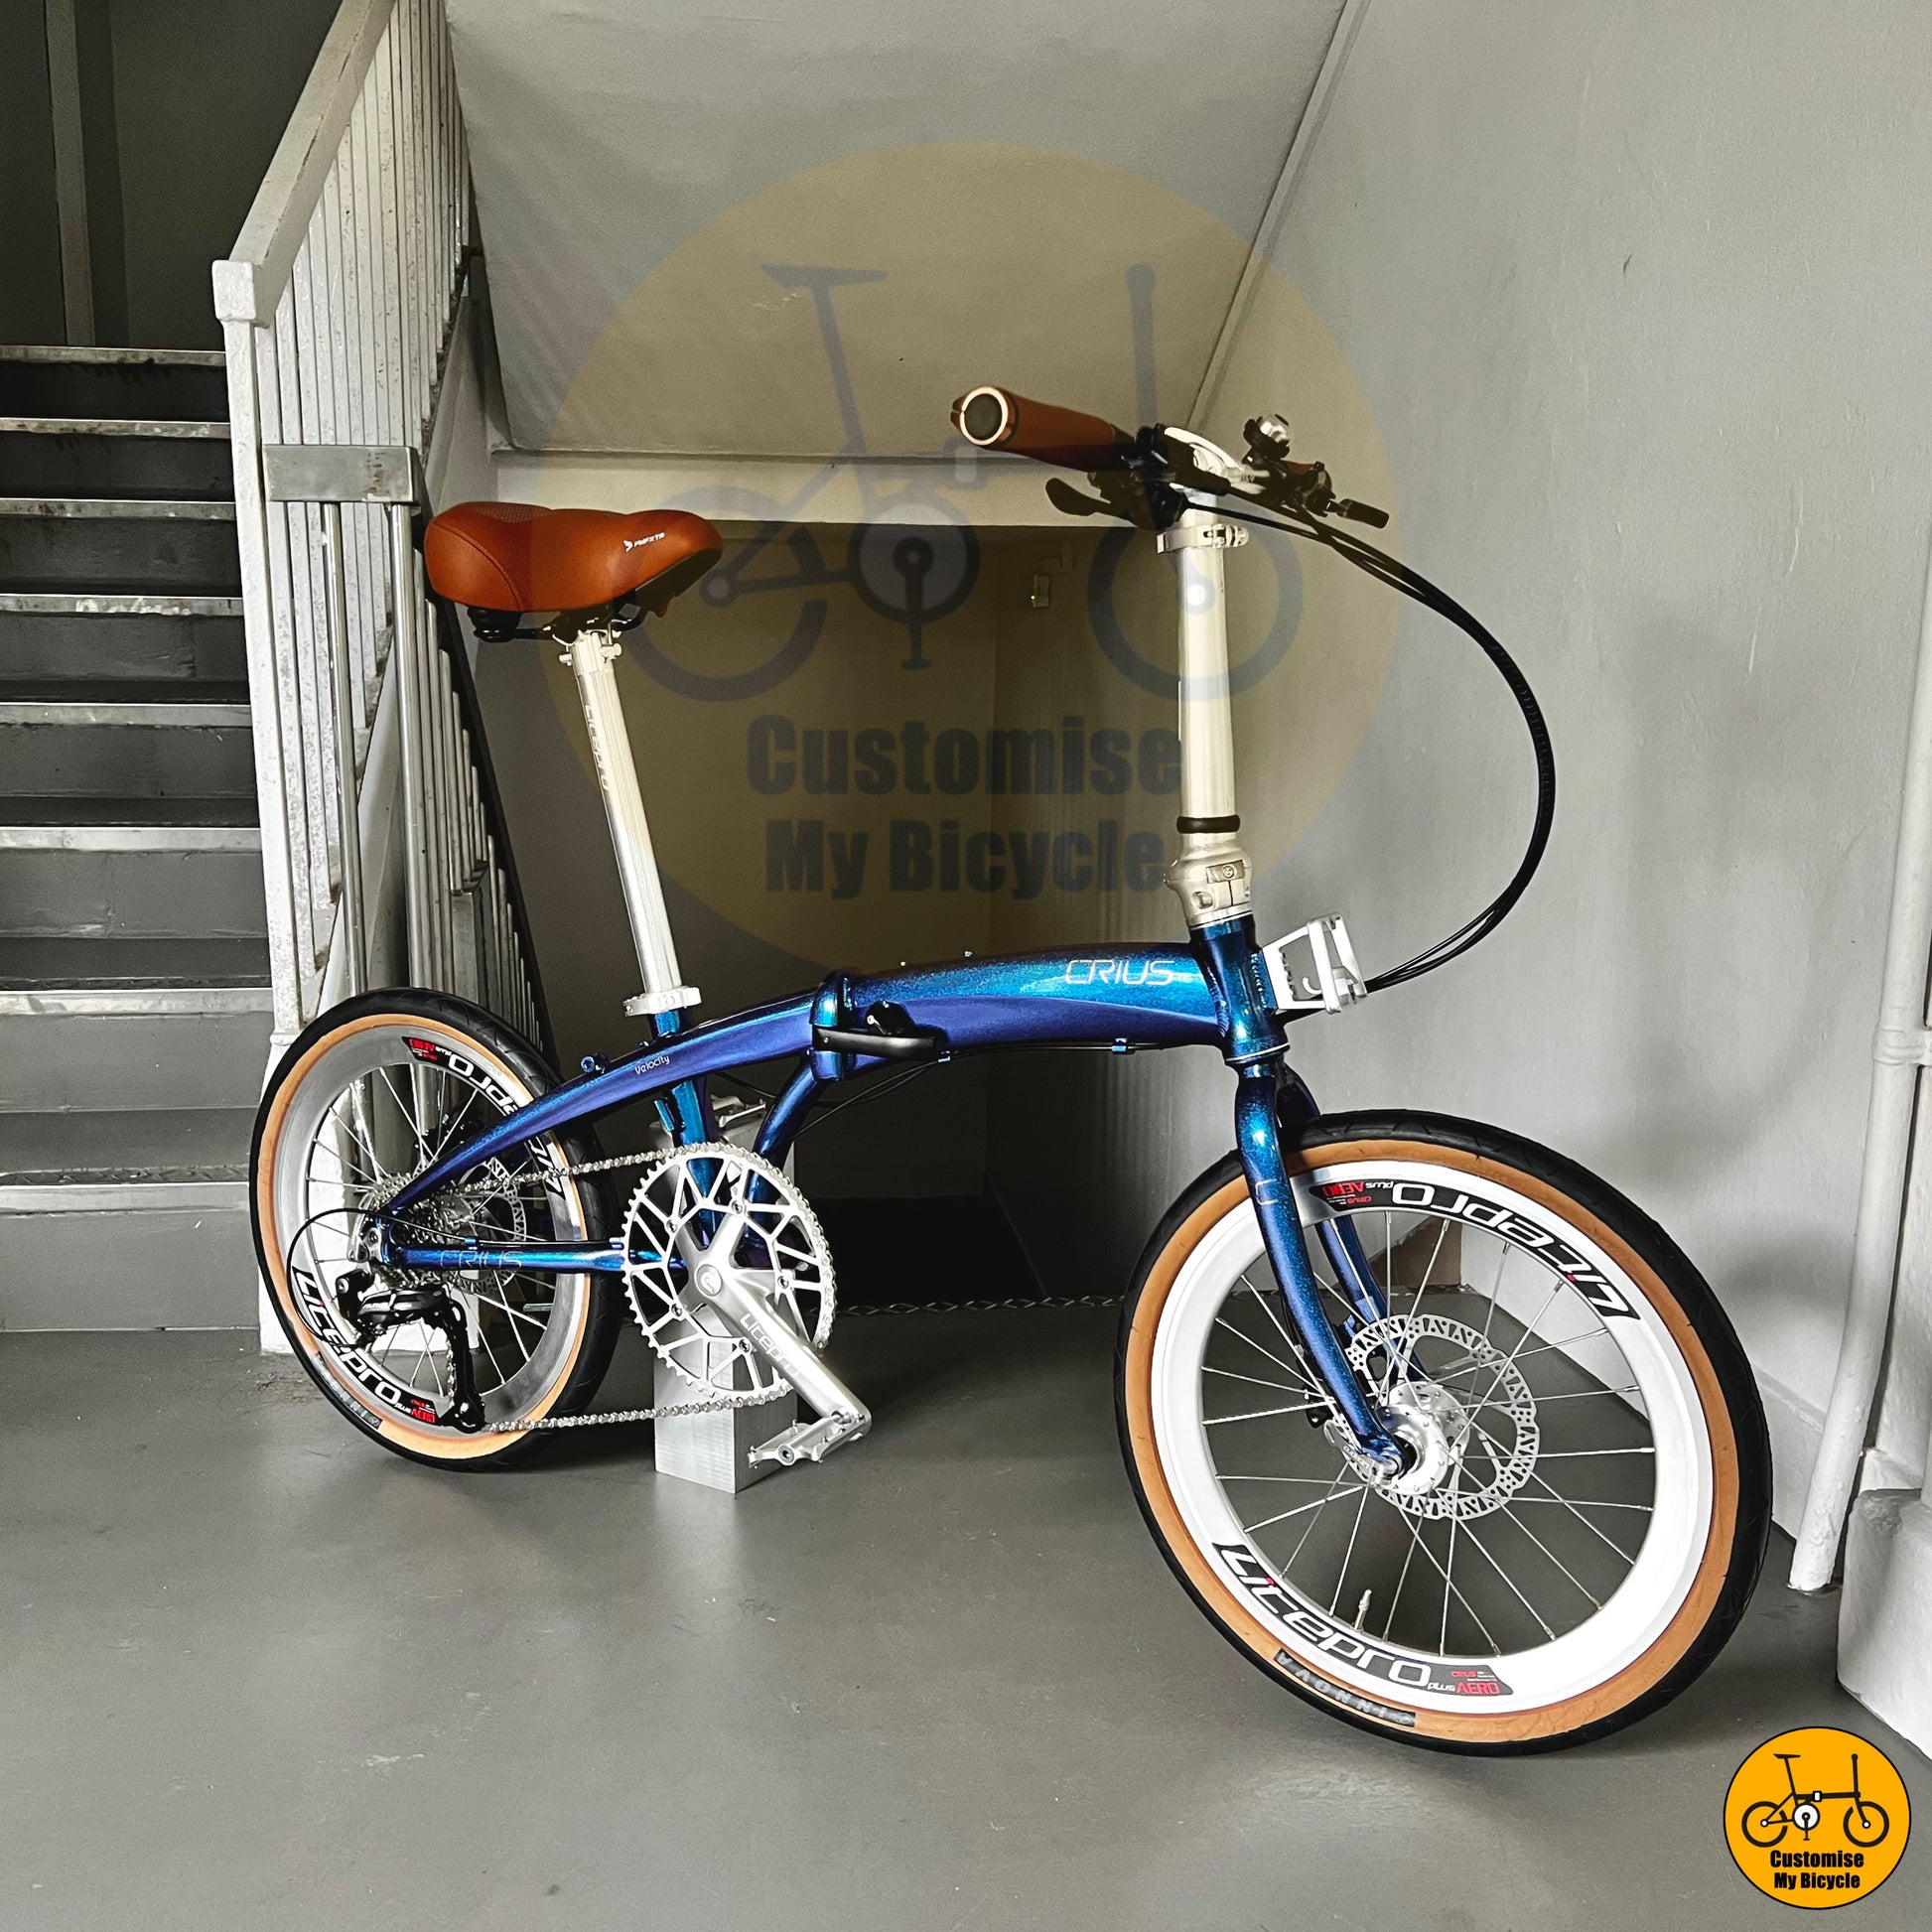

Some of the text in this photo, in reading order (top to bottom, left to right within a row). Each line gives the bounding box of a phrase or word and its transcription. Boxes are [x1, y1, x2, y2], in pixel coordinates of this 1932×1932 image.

[1064, 959, 1175, 986] CRIUS
[634, 1055, 670, 1074] Velocity
[1277, 1651, 1388, 1719] INNOVA
[1455, 1682, 1500, 1695] AERO
